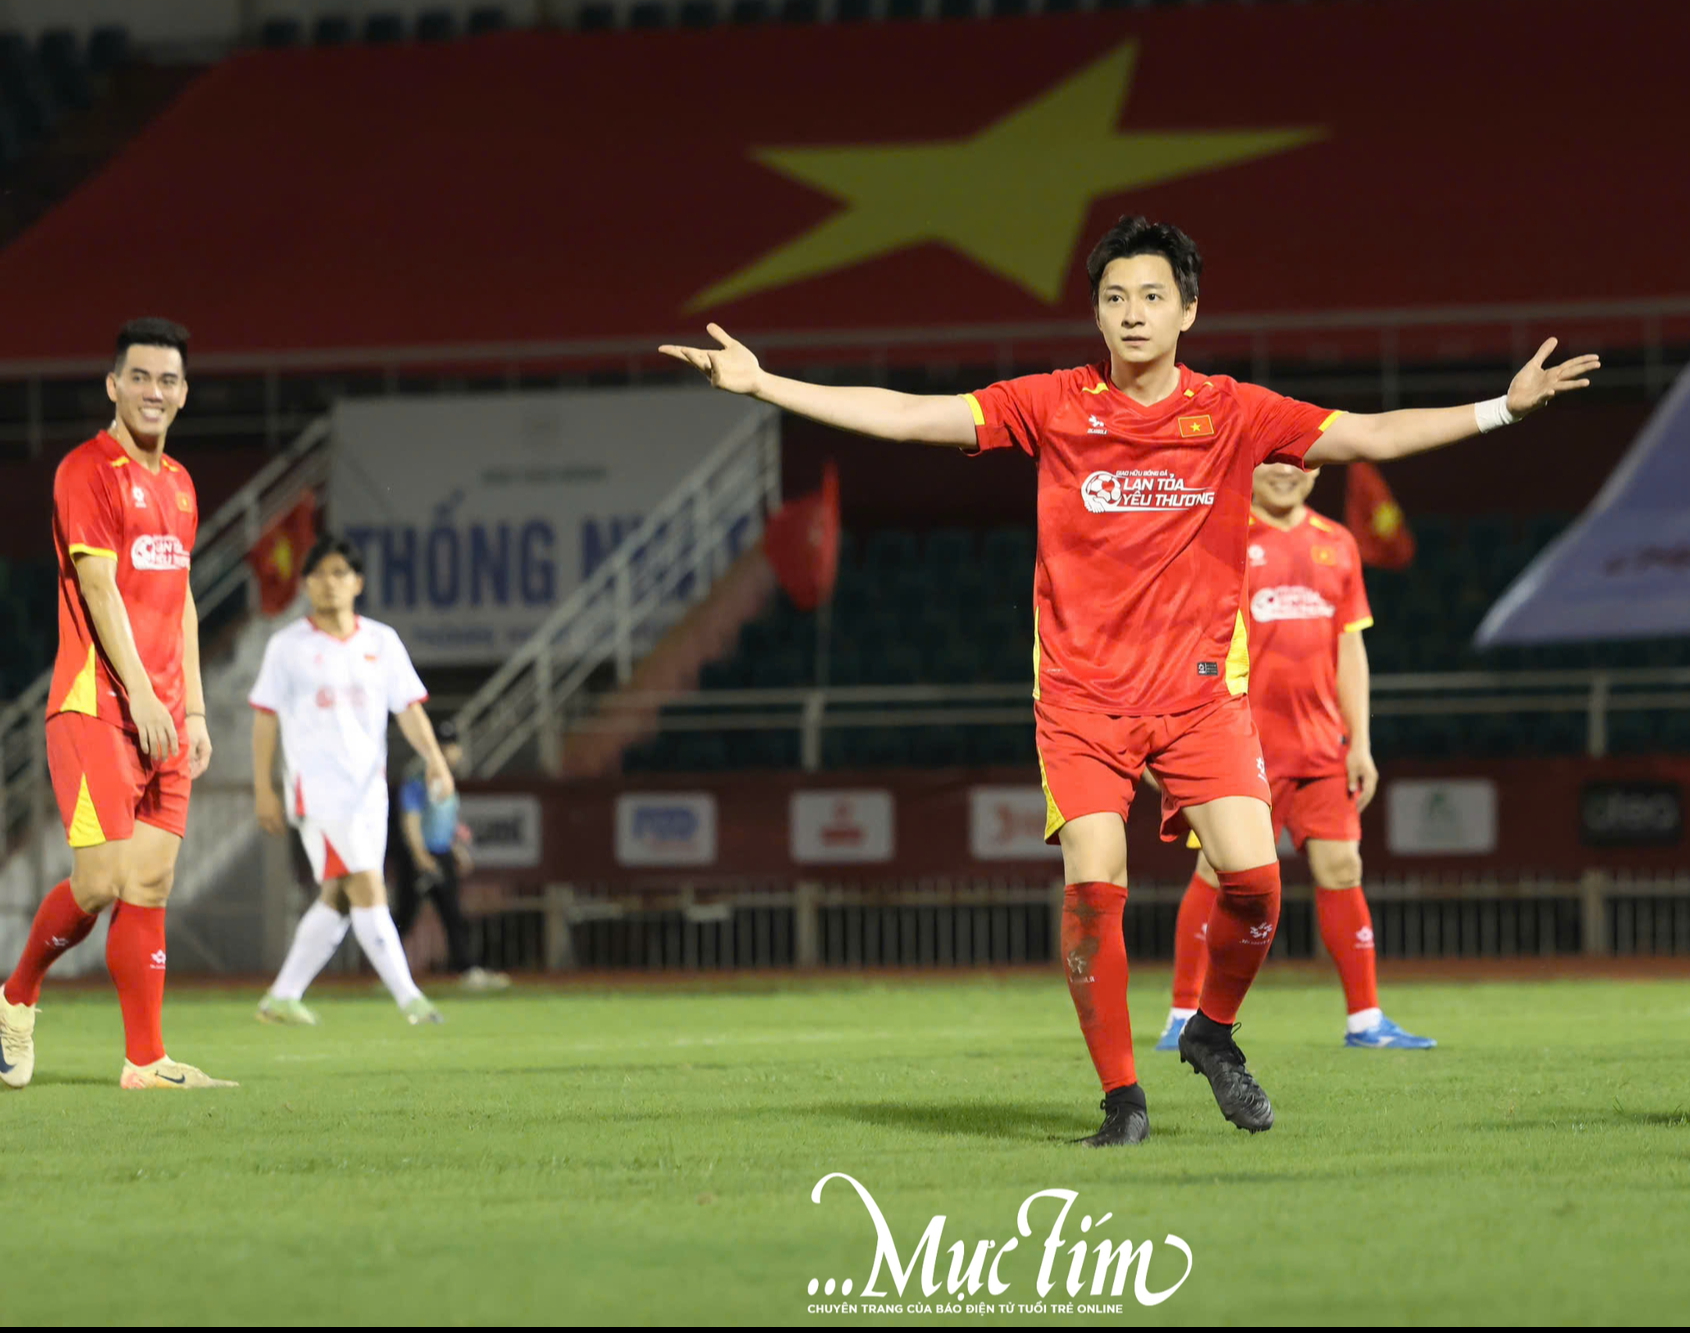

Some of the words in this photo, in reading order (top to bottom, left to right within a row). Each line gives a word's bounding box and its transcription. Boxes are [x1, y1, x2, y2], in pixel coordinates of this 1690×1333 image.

[1123, 478, 1154, 491] LAN
[1157, 473, 1184, 491] TỎA
[1123, 490, 1153, 506] YÊU
[1155, 492, 1216, 507] THƯƠNG
[344, 488, 557, 611] THỐNG
